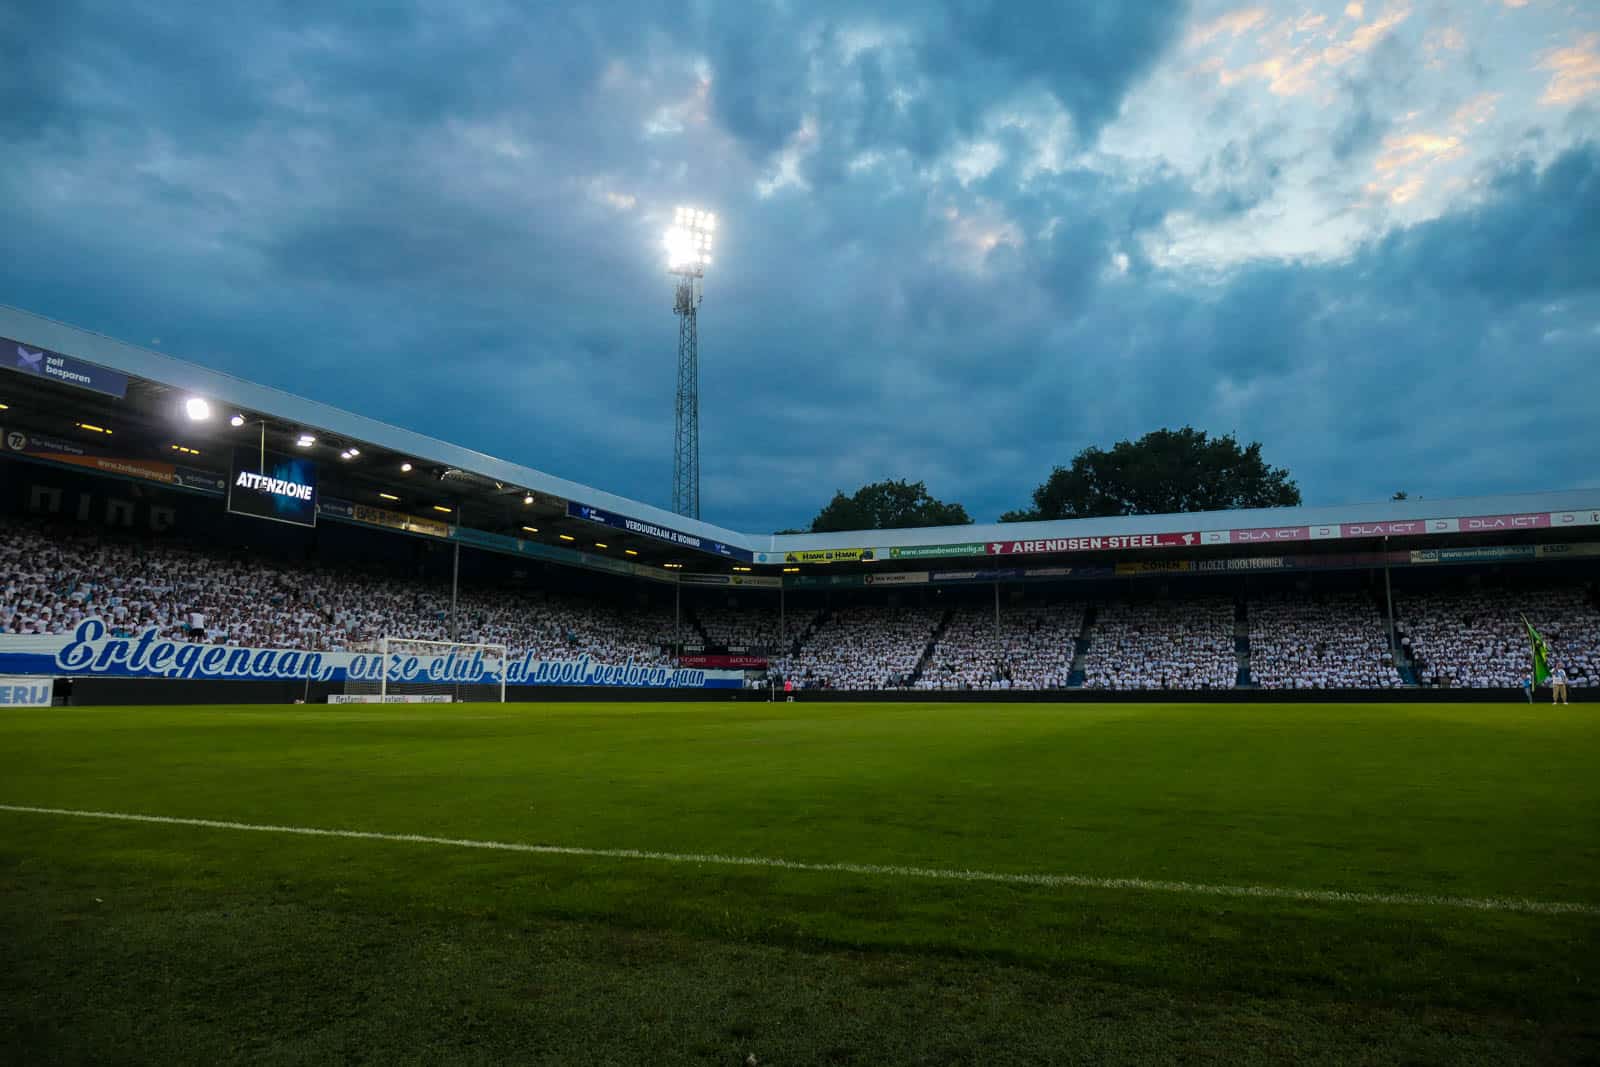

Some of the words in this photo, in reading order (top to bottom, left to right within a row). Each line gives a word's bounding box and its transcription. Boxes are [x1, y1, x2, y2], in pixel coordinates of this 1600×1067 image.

[46, 356, 64, 367] zelf
[46, 365, 91, 384] besparen
[235, 471, 313, 501] ATTENZIONE
[1390, 522, 1417, 534] ICT
[1510, 515, 1541, 526] ICT
[625, 519, 669, 539] VERDUURZAAM
[670, 531, 678, 542] JE
[678, 533, 701, 548] WONING
[1274, 528, 1301, 539] ICT
[1011, 534, 1166, 553] ARENDSEN-STEEL
[57, 617, 336, 681] Ertegenaan,
[346, 654, 421, 681] onze
[429, 646, 488, 681] club
[533, 653, 590, 682] nooit
[592, 656, 666, 686] verloren
[670, 670, 705, 688] gaan
